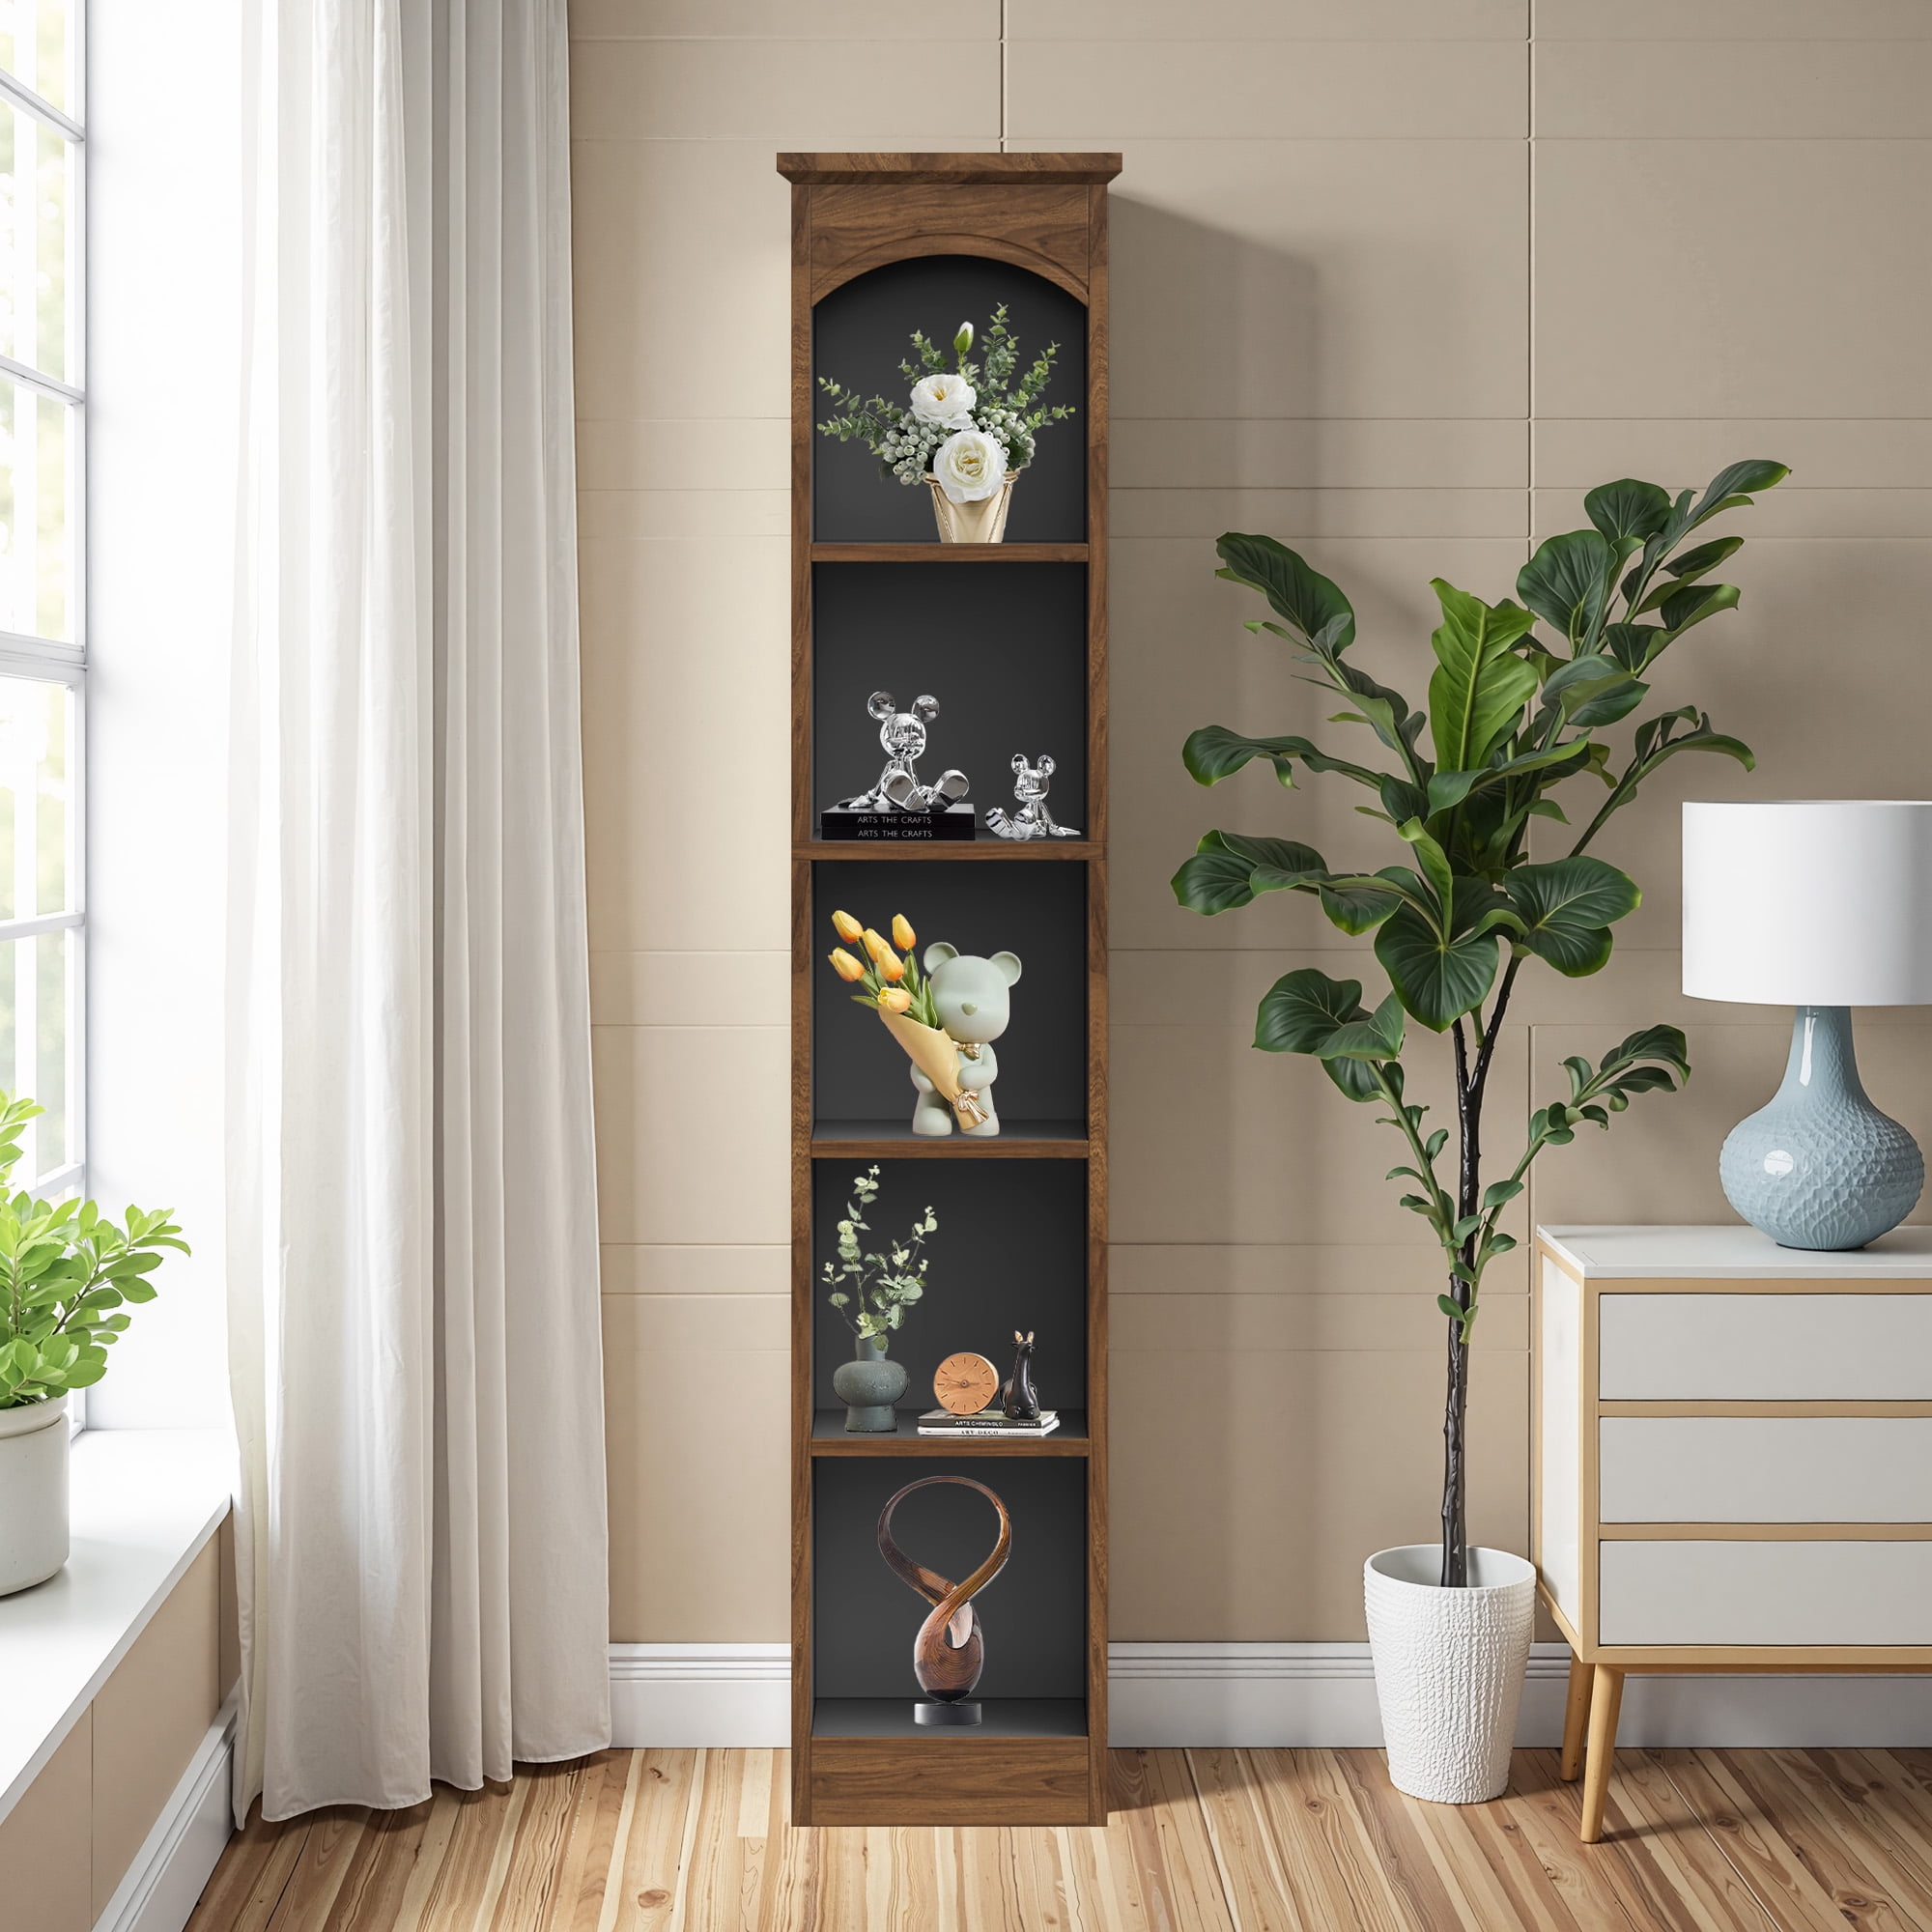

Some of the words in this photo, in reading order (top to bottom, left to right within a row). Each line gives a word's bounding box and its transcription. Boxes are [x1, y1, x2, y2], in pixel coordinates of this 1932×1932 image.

[857, 815, 878, 824] ARTS
[881, 815, 898, 824] THE
[900, 815, 932, 824] CRAFTS
